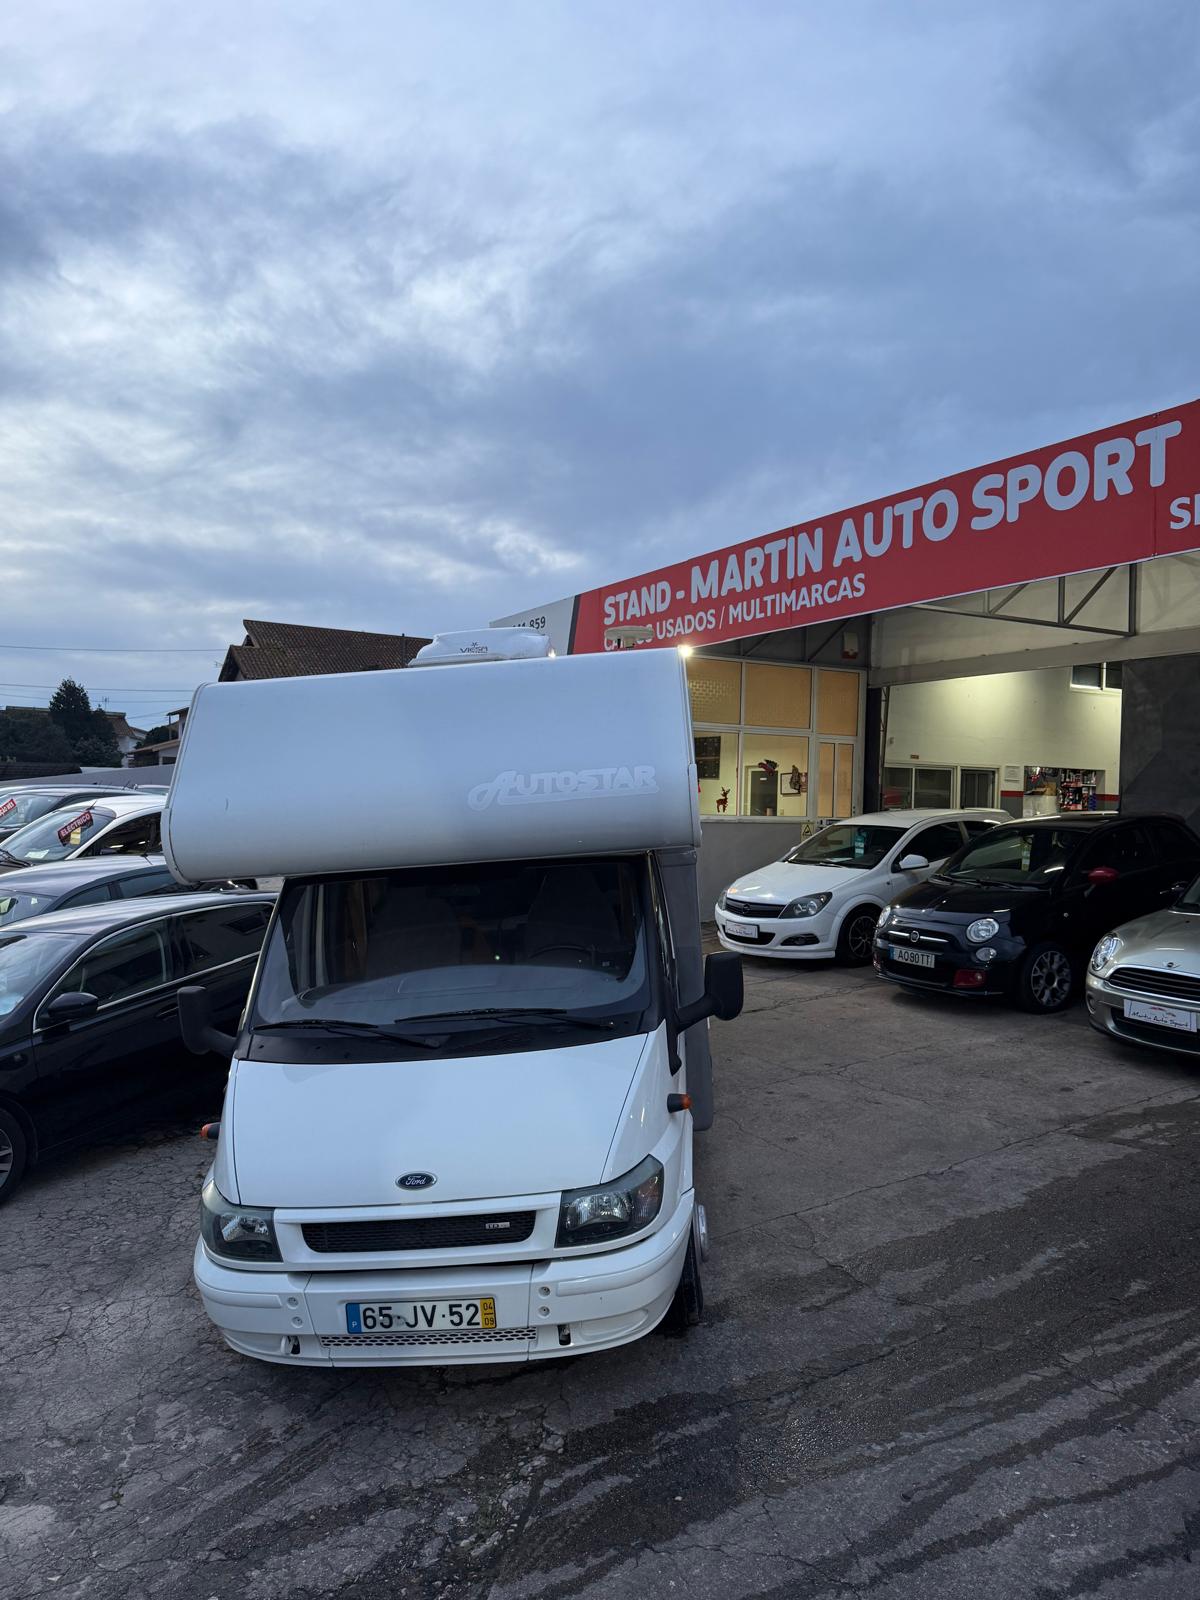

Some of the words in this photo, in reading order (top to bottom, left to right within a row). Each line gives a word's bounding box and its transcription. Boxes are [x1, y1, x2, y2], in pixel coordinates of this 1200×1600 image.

[603, 580, 672, 625] STAND
[690, 527, 823, 604] MARTIN
[832, 489, 959, 568] AUTO
[970, 420, 1182, 531] SPORT
[656, 609, 715, 640] USADOS
[728, 573, 865, 624] MULTIMARCAS
[468, 765, 658, 811] AUTOSTAR
[405, 1176, 427, 1186] Ford
[482, 1302, 493, 1311] 04
[484, 1316, 495, 1326] 09
